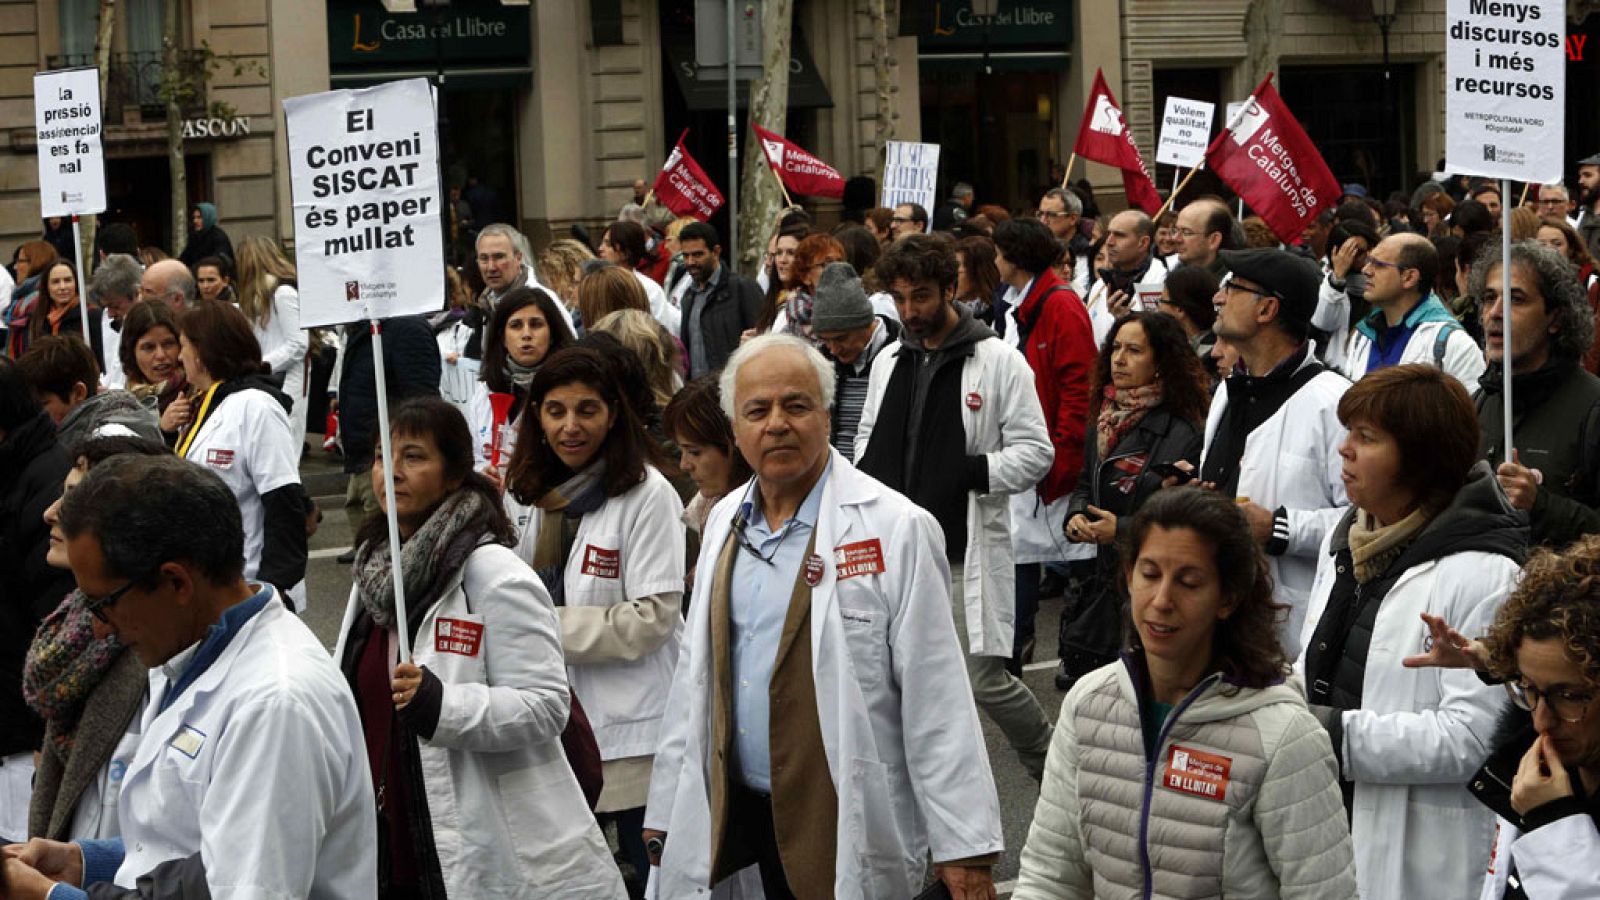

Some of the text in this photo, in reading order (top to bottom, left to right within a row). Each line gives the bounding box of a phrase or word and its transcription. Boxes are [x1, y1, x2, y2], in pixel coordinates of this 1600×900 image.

[1015, 7, 1054, 25] Llibre
[1470, 0, 1541, 23] Menys
[381, 20, 425, 40] Casa
[456, 17, 506, 37] Llibre
[1450, 20, 1559, 48] discursos
[1475, 48, 1534, 72] i més
[1455, 77, 1554, 100] recursos
[346, 108, 374, 133] El
[1173, 104, 1206, 118] Volem
[1178, 129, 1193, 138] no
[75, 139, 89, 154] fa
[306, 132, 421, 169] Conveni
[313, 162, 419, 198] SISCAT
[785, 160, 841, 179] Catalunya
[1260, 127, 1317, 208] Metges de
[676, 163, 720, 207] Metges de
[1248, 144, 1307, 218] Catalunya
[669, 173, 712, 216] Catalunya
[305, 196, 431, 229] és paper
[324, 224, 415, 256] mullat
